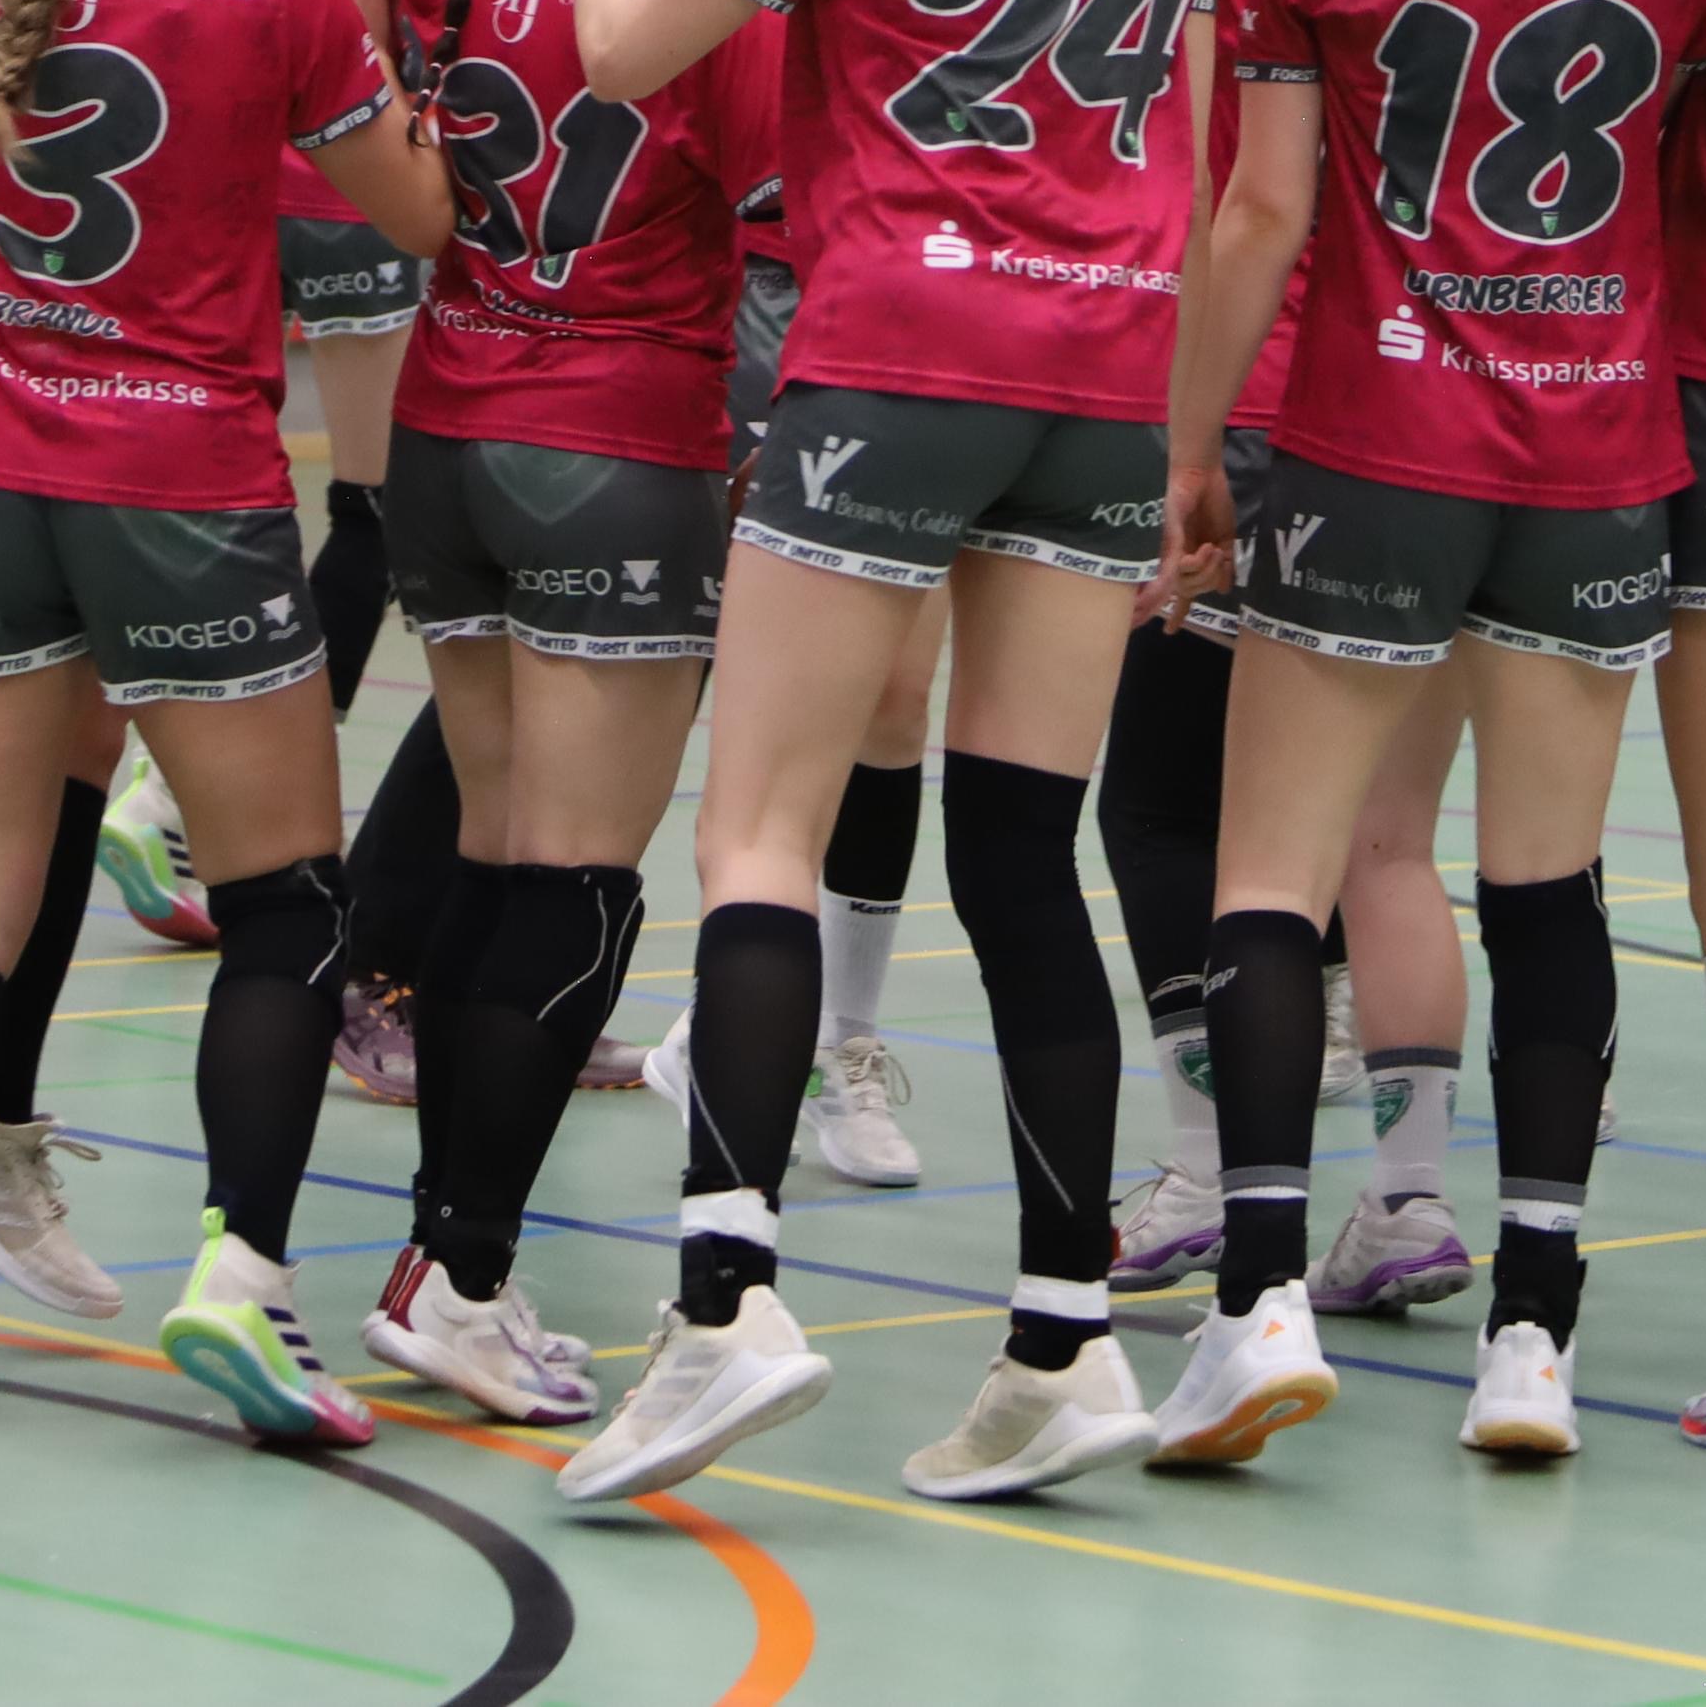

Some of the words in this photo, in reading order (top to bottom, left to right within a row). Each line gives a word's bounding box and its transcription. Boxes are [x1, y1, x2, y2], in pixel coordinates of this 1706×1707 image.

[989, 247, 1183, 295] Kreissparkass
[1572, 567, 1662, 610] KDGEO
[125, 615, 258, 650] KDGEO
[1336, 641, 1386, 660] FORST
